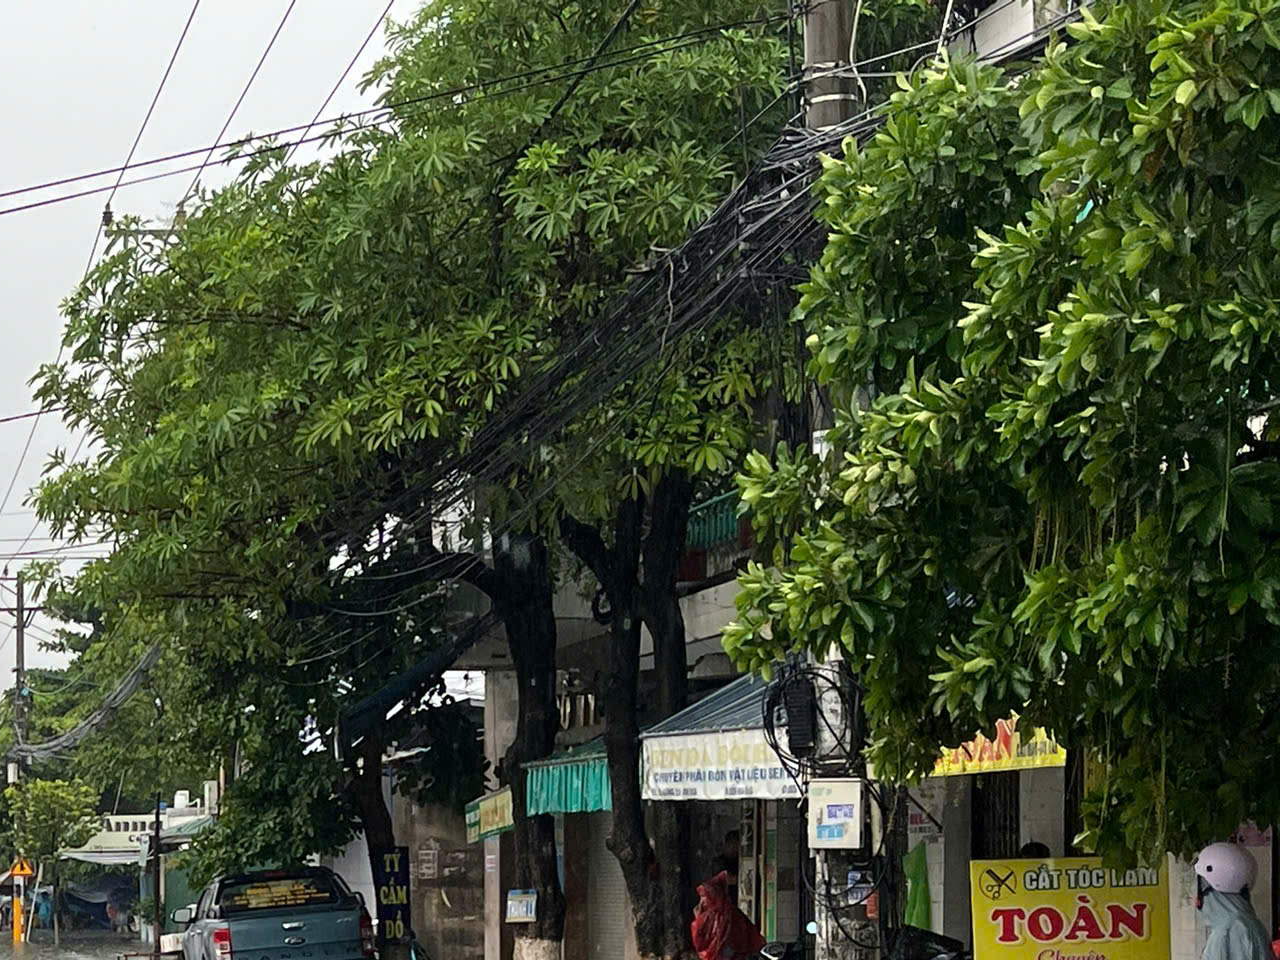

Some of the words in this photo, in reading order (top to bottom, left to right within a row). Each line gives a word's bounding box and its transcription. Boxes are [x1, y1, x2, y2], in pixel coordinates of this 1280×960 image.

[1023, 863, 1062, 891] CẮT
[1066, 864, 1105, 889] TÓC
[991, 895, 1148, 943] TOÀN
